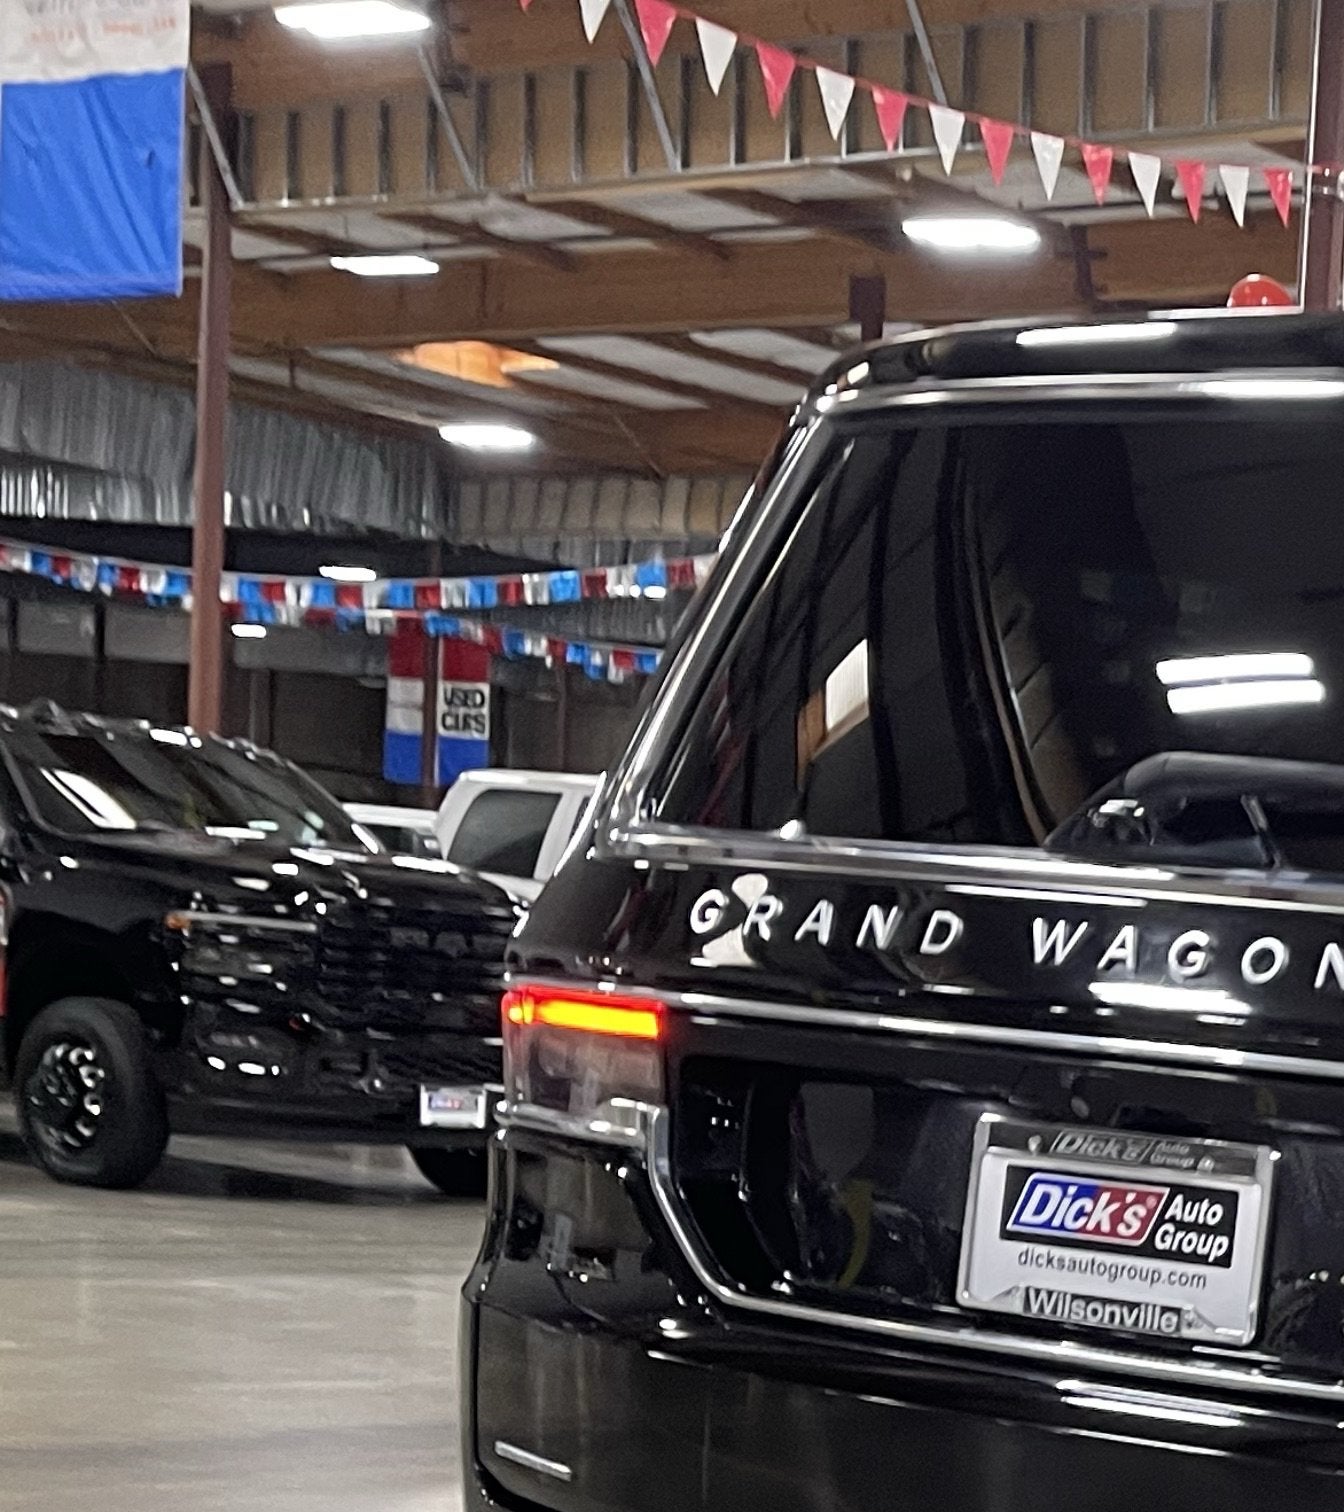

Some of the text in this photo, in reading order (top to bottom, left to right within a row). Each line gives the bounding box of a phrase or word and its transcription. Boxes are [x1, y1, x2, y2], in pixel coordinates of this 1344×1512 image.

[690, 888, 964, 955] GRAND
[1018, 1182, 1147, 1237] Dick's
[1164, 1193, 1224, 1226] Auto
[1153, 1223, 1229, 1263] Group
[1017, 1246, 1207, 1289] dicksautogroup.com
[1027, 1286, 1179, 1333] Wilsonville
